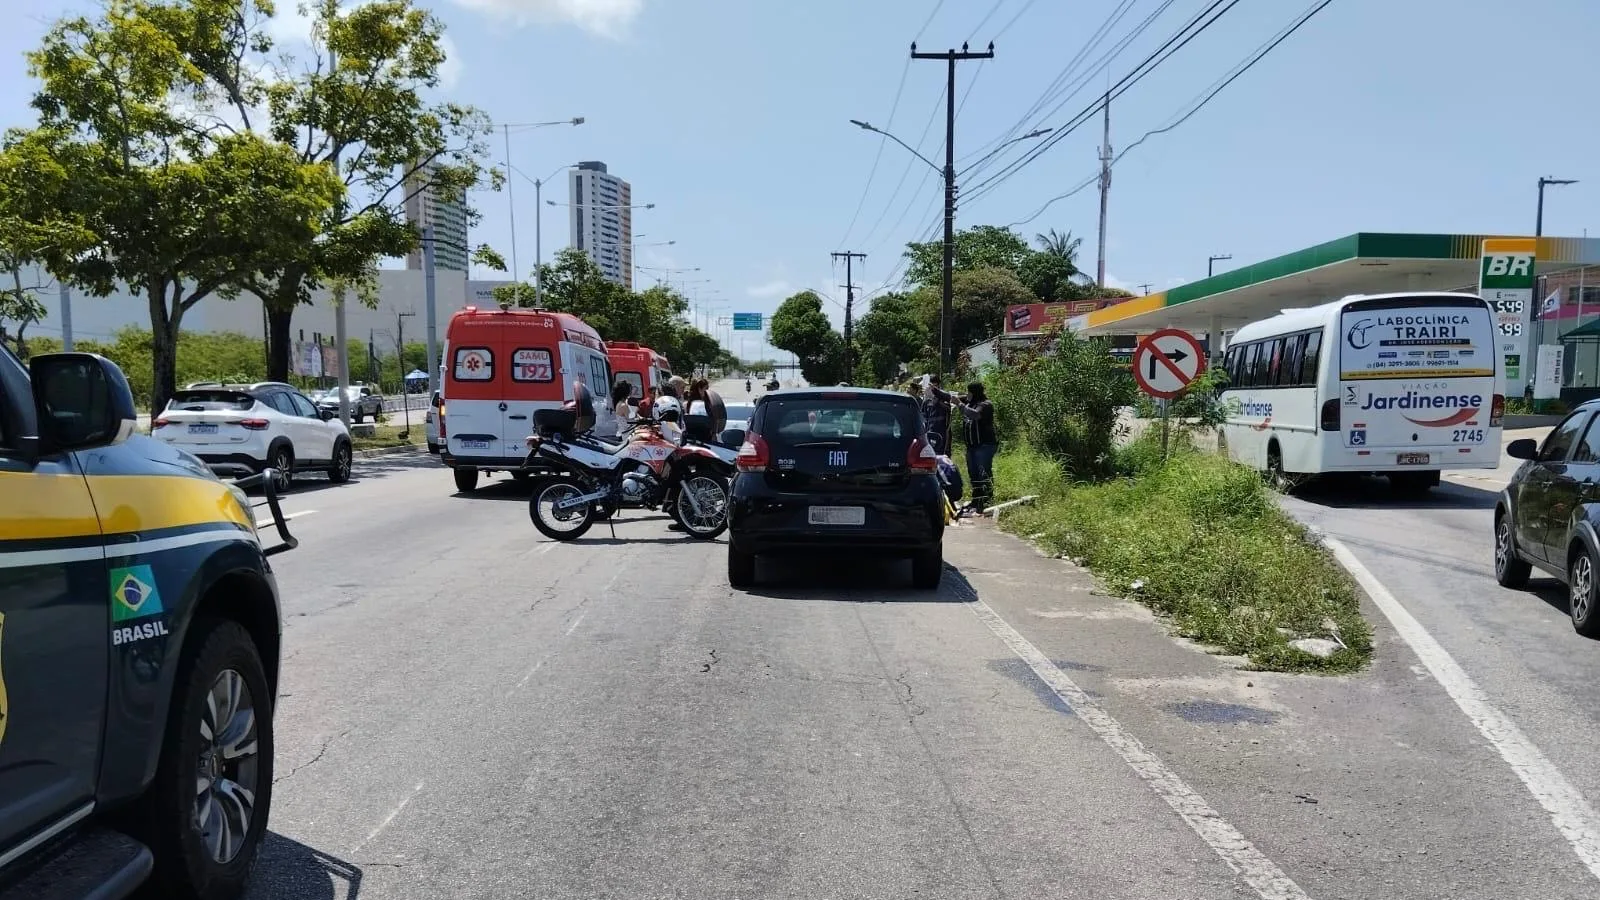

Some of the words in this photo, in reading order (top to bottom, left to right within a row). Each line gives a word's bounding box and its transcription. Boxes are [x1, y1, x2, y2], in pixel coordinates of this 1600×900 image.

[1487, 256, 1531, 276] BR
[1378, 314, 1469, 326] LABOCLÍNICA
[1394, 326, 1456, 339] TRAIRI
[519, 351, 549, 360] SAMU
[520, 364, 549, 378] 192
[1361, 391, 1482, 410] Jardinense
[1452, 430, 1483, 442] 2745
[828, 451, 848, 466] FIAT
[112, 621, 168, 646] BRASIL
